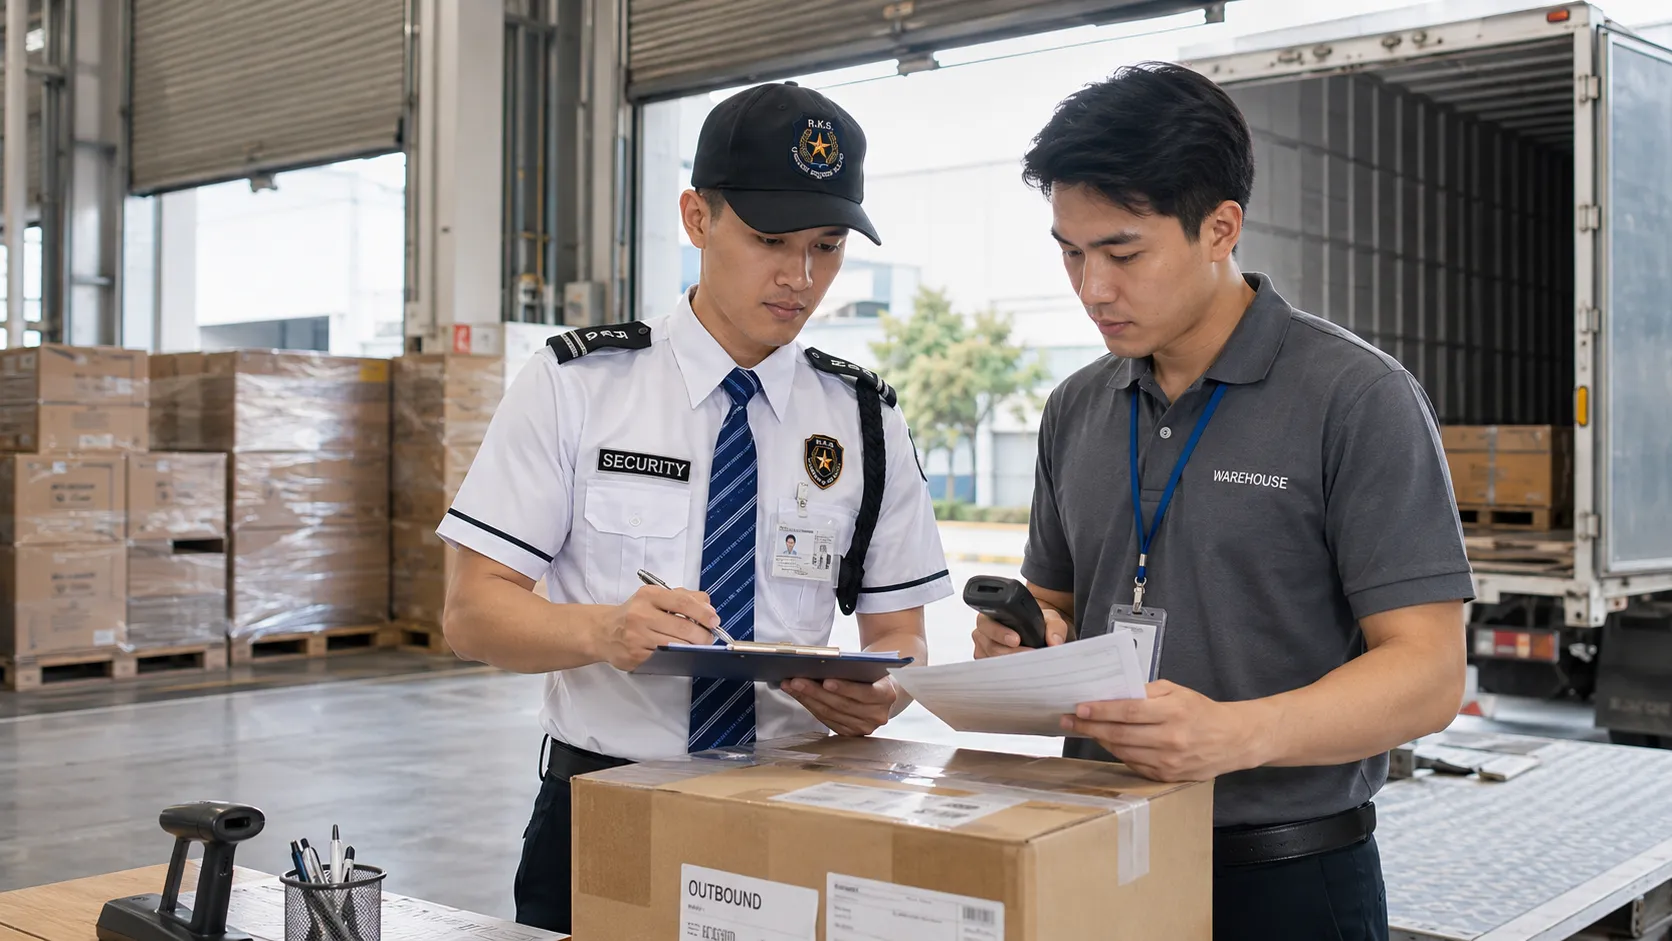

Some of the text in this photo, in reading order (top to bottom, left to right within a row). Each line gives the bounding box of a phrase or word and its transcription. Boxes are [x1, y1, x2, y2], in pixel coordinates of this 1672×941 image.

[808, 119, 834, 131] R.K.S.
[603, 453, 686, 477] SECURITY
[1213, 470, 1288, 489] WAREHOUSE
[688, 880, 762, 910] OUTBOUND
